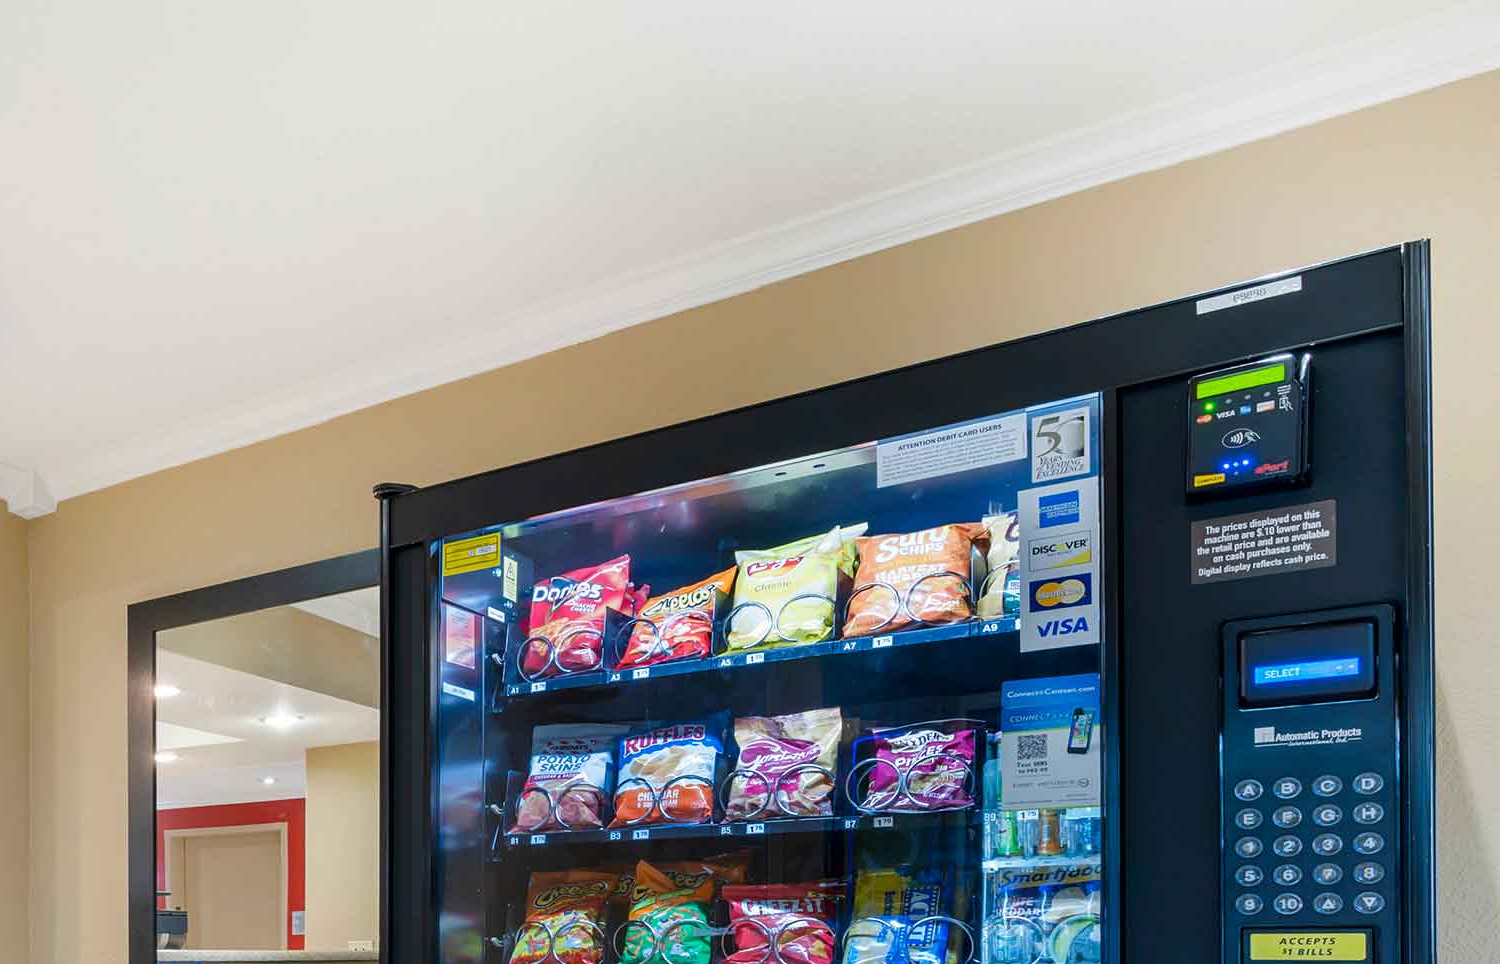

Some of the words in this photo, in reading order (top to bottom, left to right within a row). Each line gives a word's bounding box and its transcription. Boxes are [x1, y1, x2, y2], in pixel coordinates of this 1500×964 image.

[898, 436, 936, 451] ATTENTION
[937, 433, 957, 444] DEBIT
[958, 428, 978, 439] CARD
[979, 423, 1002, 435] USERS
[1205, 526, 1220, 535] The
[1221, 522, 1248, 536] prices
[1249, 514, 1289, 529] displayed
[1291, 513, 1302, 521] on
[1303, 510, 1320, 520] this
[1204, 531, 1239, 545] machine
[1241, 531, 1255, 540] are
[1256, 525, 1275, 537] $.10
[1276, 524, 1300, 534] lower
[1302, 521, 1322, 531] than
[1197, 546, 1210, 556] the
[1211, 543, 1233, 554] retail
[1234, 540, 1256, 552] price
[1257, 536, 1273, 546] and
[1275, 535, 1289, 544] are
[1291, 529, 1330, 542] available
[1212, 554, 1223, 563] on
[1225, 551, 1245, 561] cash
[1246, 545, 1291, 560] purchases
[1292, 541, 1313, 552] only.
[1198, 565, 1222, 578] Digital
[1223, 562, 1251, 573] display
[1252, 558, 1282, 569] reflects
[1284, 555, 1303, 565] cash
[1304, 552, 1329, 564] price.
[983, 624, 998, 633] A9
[1037, 616, 1089, 638] VISA
[844, 642, 857, 651] A7
[721, 658, 731, 667] A5
[611, 674, 620, 682] A3
[1264, 667, 1301, 680] SELECT
[511, 686, 520, 694] A1
[624, 726, 705, 757] RUFFLES
[1276, 730, 1320, 742] Automatic
[1321, 728, 1362, 739] Products
[538, 753, 591, 764] POTATO
[540, 762, 581, 772] SKINS
[1243, 784, 1255, 796] A
[1281, 783, 1294, 794] B
[1320, 780, 1334, 792] C
[1361, 778, 1375, 790] D
[1243, 813, 1255, 825] E
[1282, 811, 1294, 823] F
[1321, 809, 1335, 821] G
[1362, 808, 1375, 820] H
[845, 819, 856, 829] B7
[610, 832, 621, 841] B3
[1244, 842, 1253, 853] 1
[1283, 841, 1294, 852] 2
[1322, 839, 1334, 850] 3
[1363, 837, 1375, 849] 4
[1244, 870, 1254, 882] 5
[1283, 869, 1294, 881] 6
[1323, 868, 1334, 880] 7
[1363, 867, 1375, 879] 8
[1244, 899, 1255, 911] 9
[1279, 898, 1297, 910] 10
[1278, 937, 1337, 946] ACCEPTS
[1282, 948, 1295, 957] $1
[1298, 948, 1333, 957] BILLS
